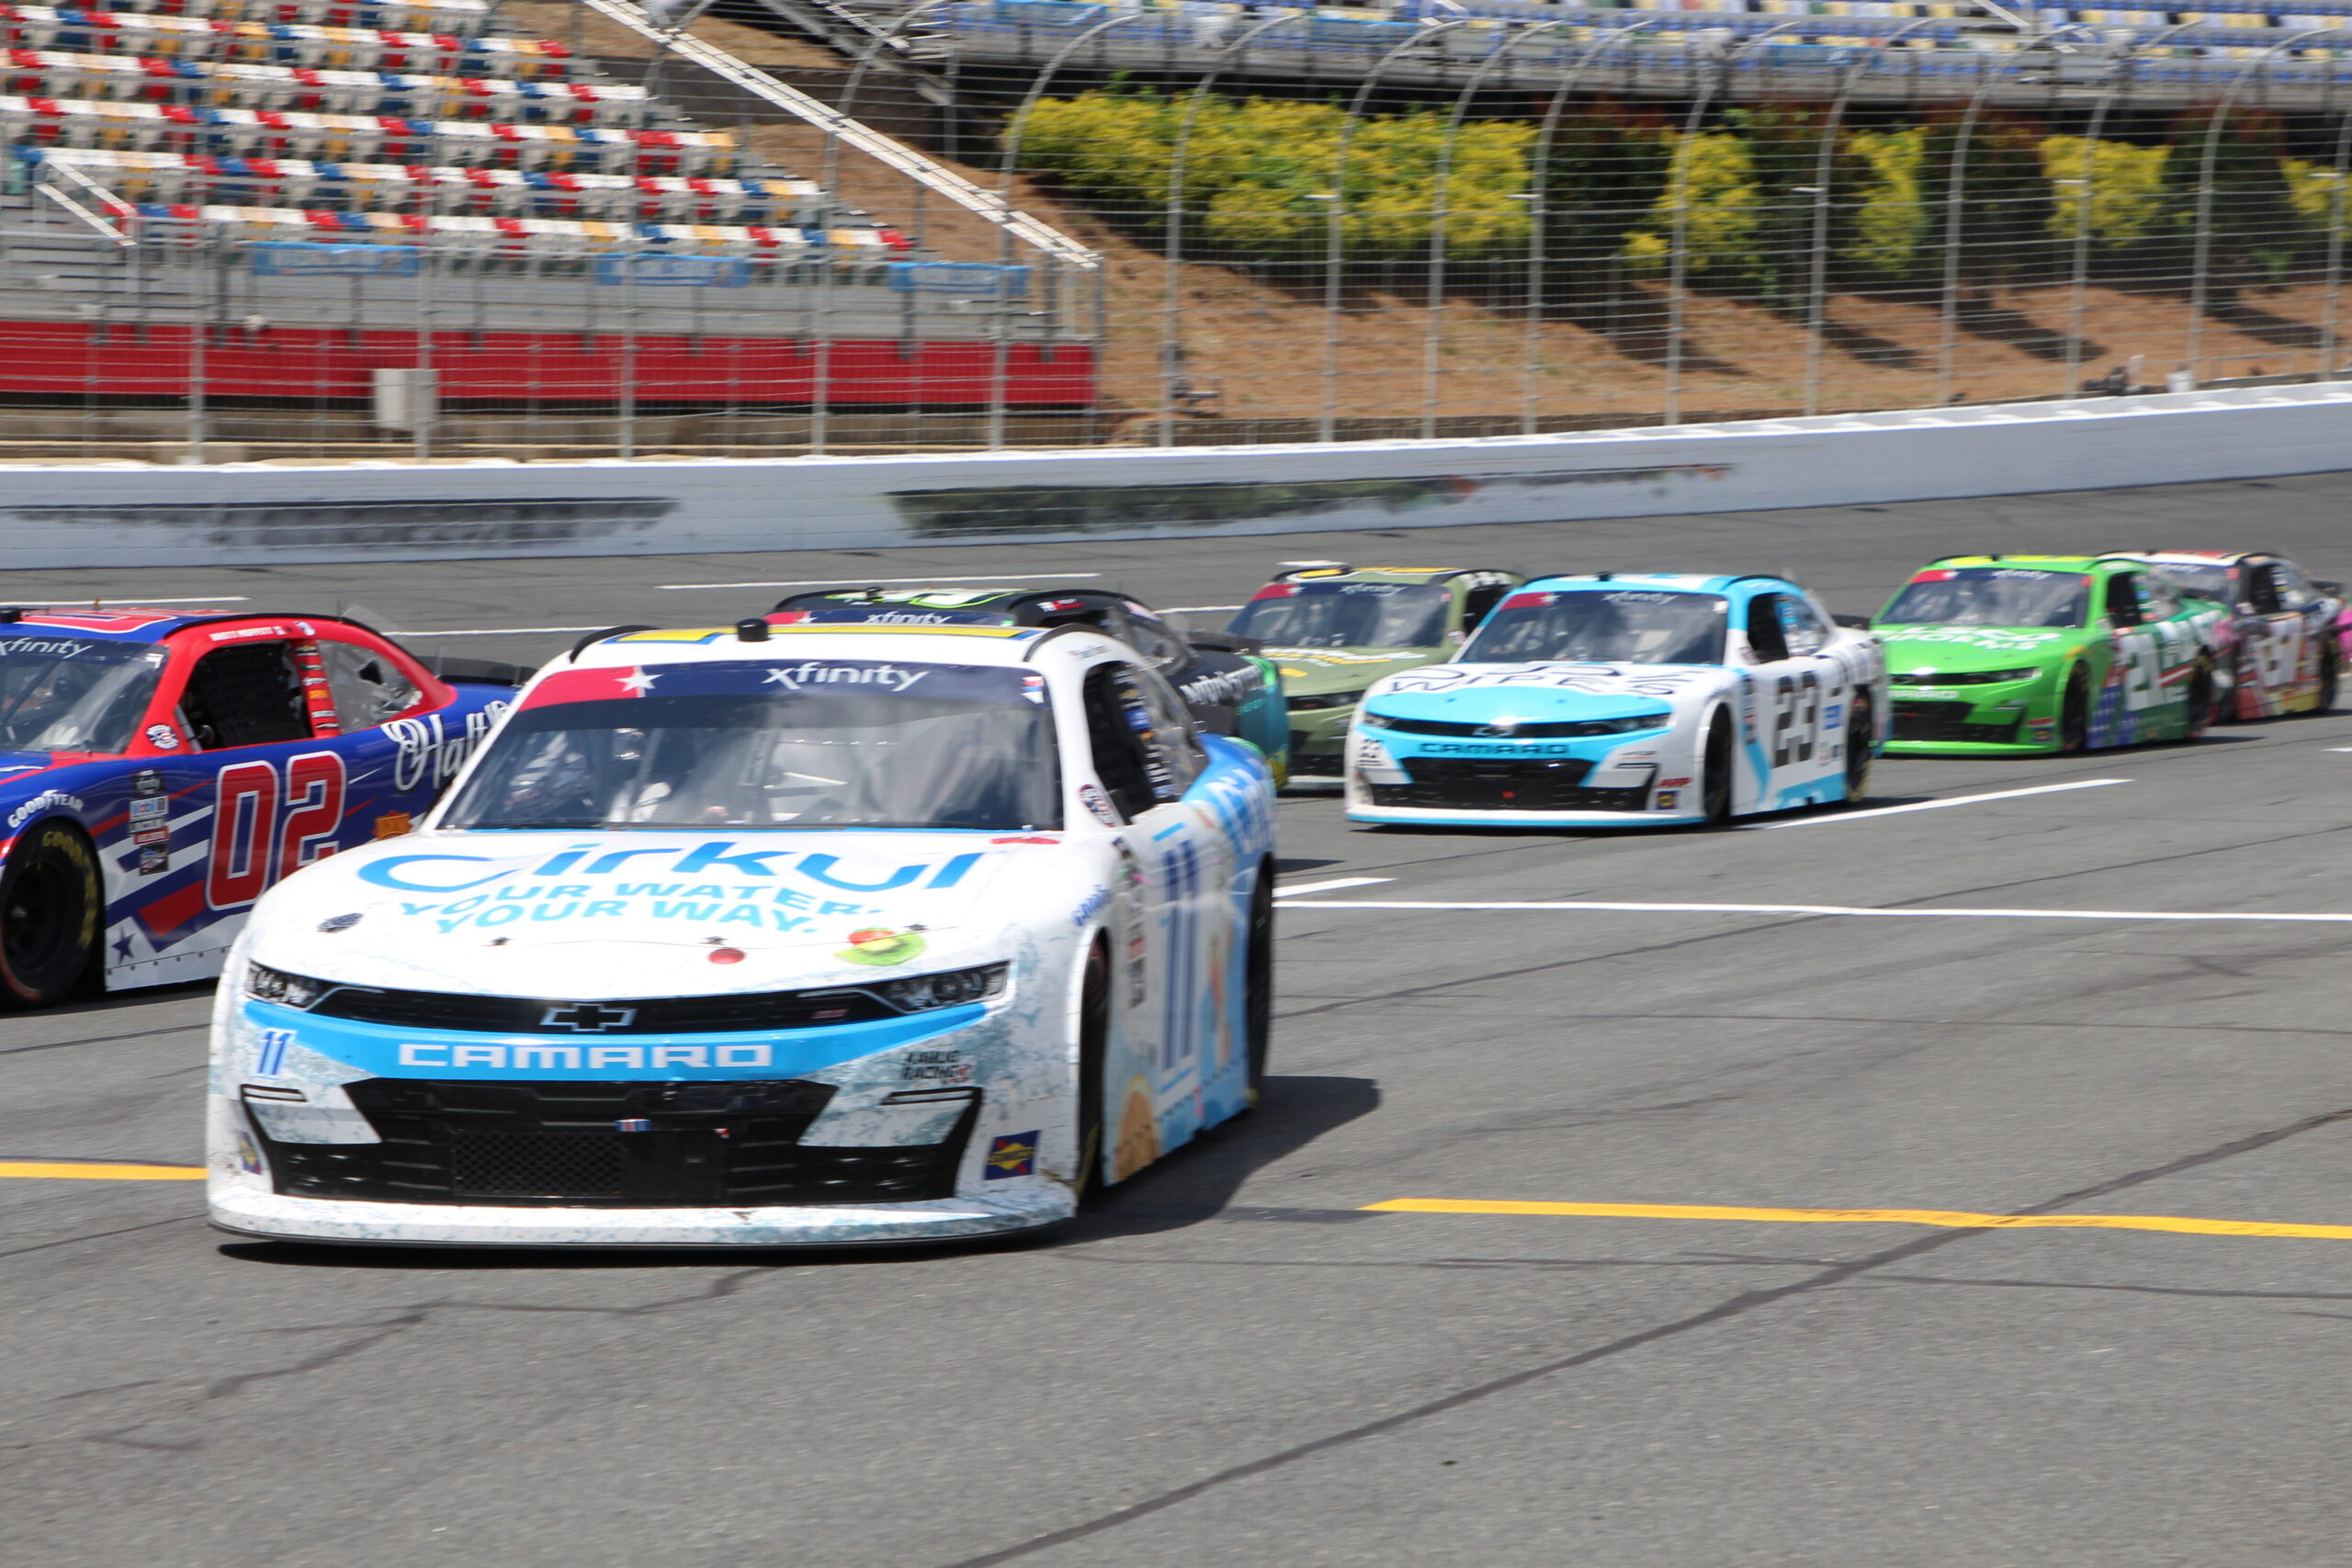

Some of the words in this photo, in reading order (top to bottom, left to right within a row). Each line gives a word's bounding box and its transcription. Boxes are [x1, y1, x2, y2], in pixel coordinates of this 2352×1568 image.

[865, 610, 953, 626] xfinity
[762, 660, 931, 693] xfinity
[1771, 671, 1819, 769] 23
[1418, 742, 1570, 756] CAMARO
[7, 788, 84, 829] GOODYEAR
[205, 750, 346, 911] 02
[356, 840, 986, 893] Cirkul
[399, 884, 592, 916] YOUR
[613, 883, 885, 915] WATER.
[434, 900, 625, 934] YOUR
[650, 901, 820, 933] WAY.
[251, 1028, 298, 1079] 11
[398, 1044, 772, 1069] CAMARO
